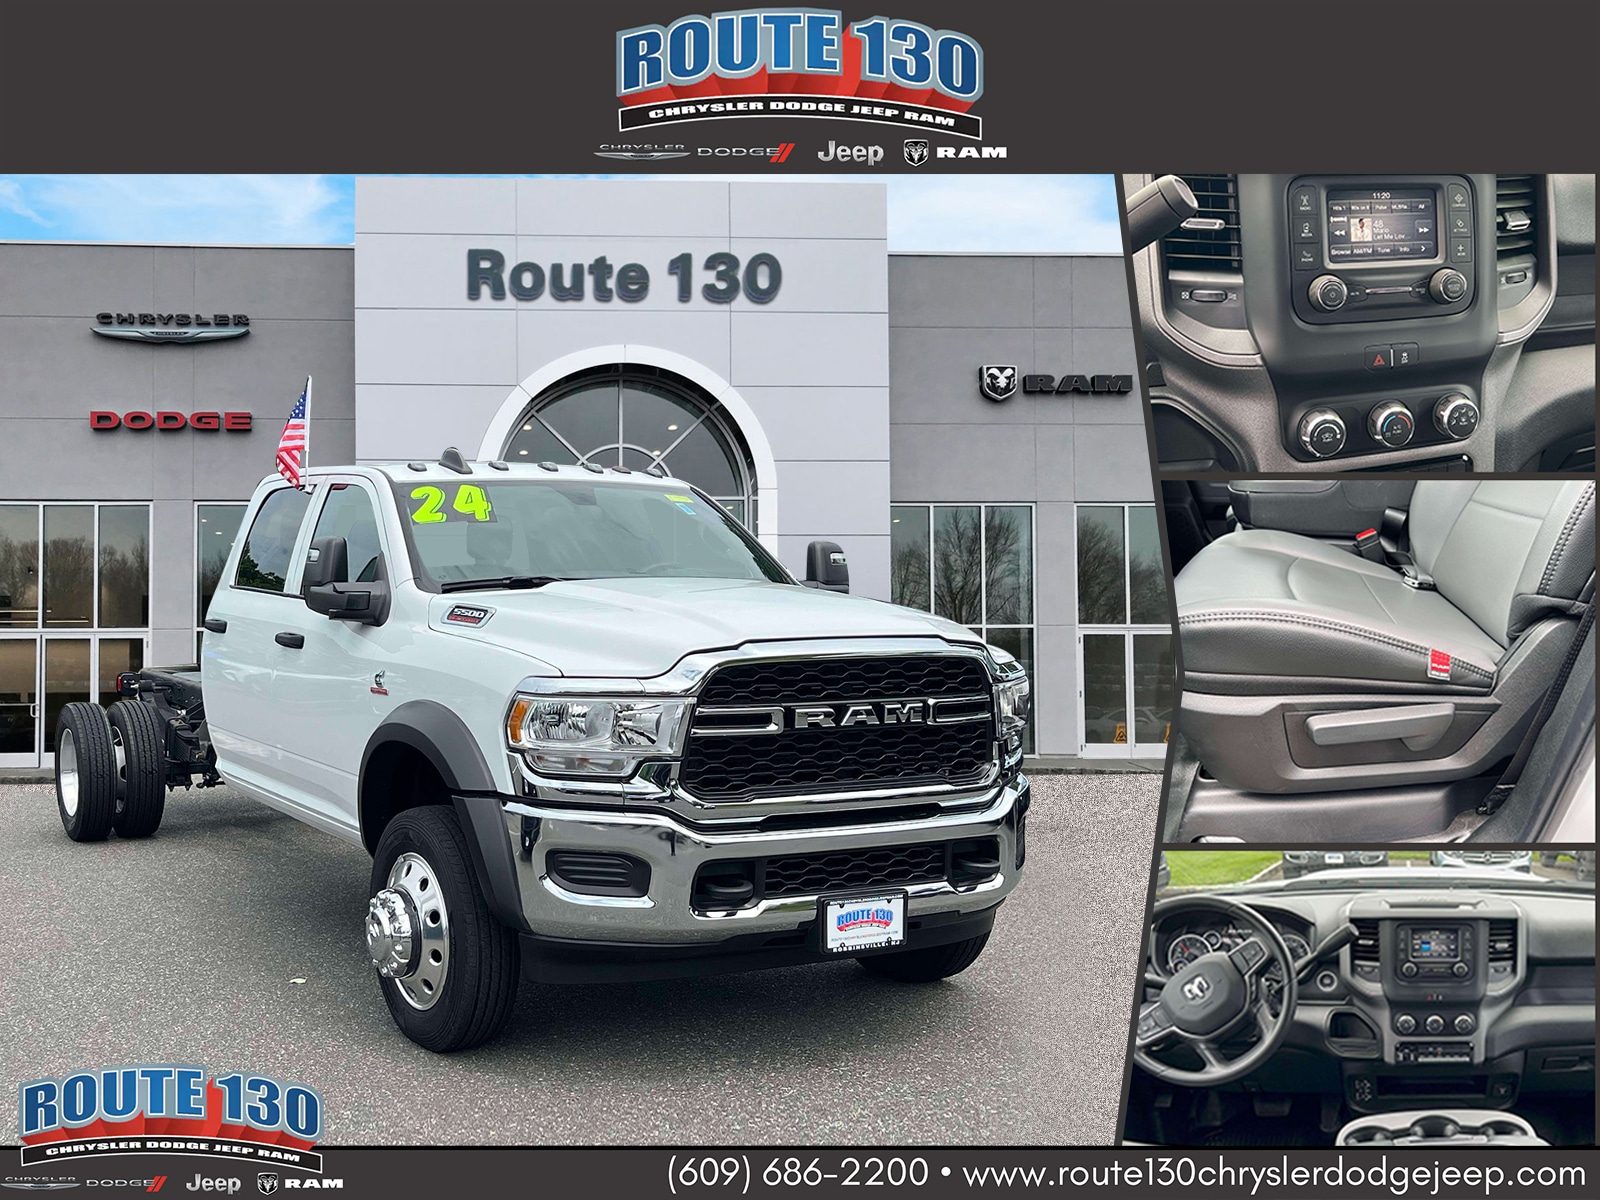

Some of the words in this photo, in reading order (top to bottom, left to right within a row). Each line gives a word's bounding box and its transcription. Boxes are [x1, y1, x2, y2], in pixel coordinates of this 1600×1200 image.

[467, 248, 650, 301] Route
[668, 252, 782, 304] 130
[96, 312, 250, 327] CHRYSLER
[1023, 374, 1133, 394] RAM
[90, 410, 253, 431] DODGE
[410, 484, 492, 523] 24
[453, 608, 485, 618] 5500
[794, 702, 924, 728] RAM
[837, 909, 871, 926] ROUTE
[874, 908, 893, 922] 130
